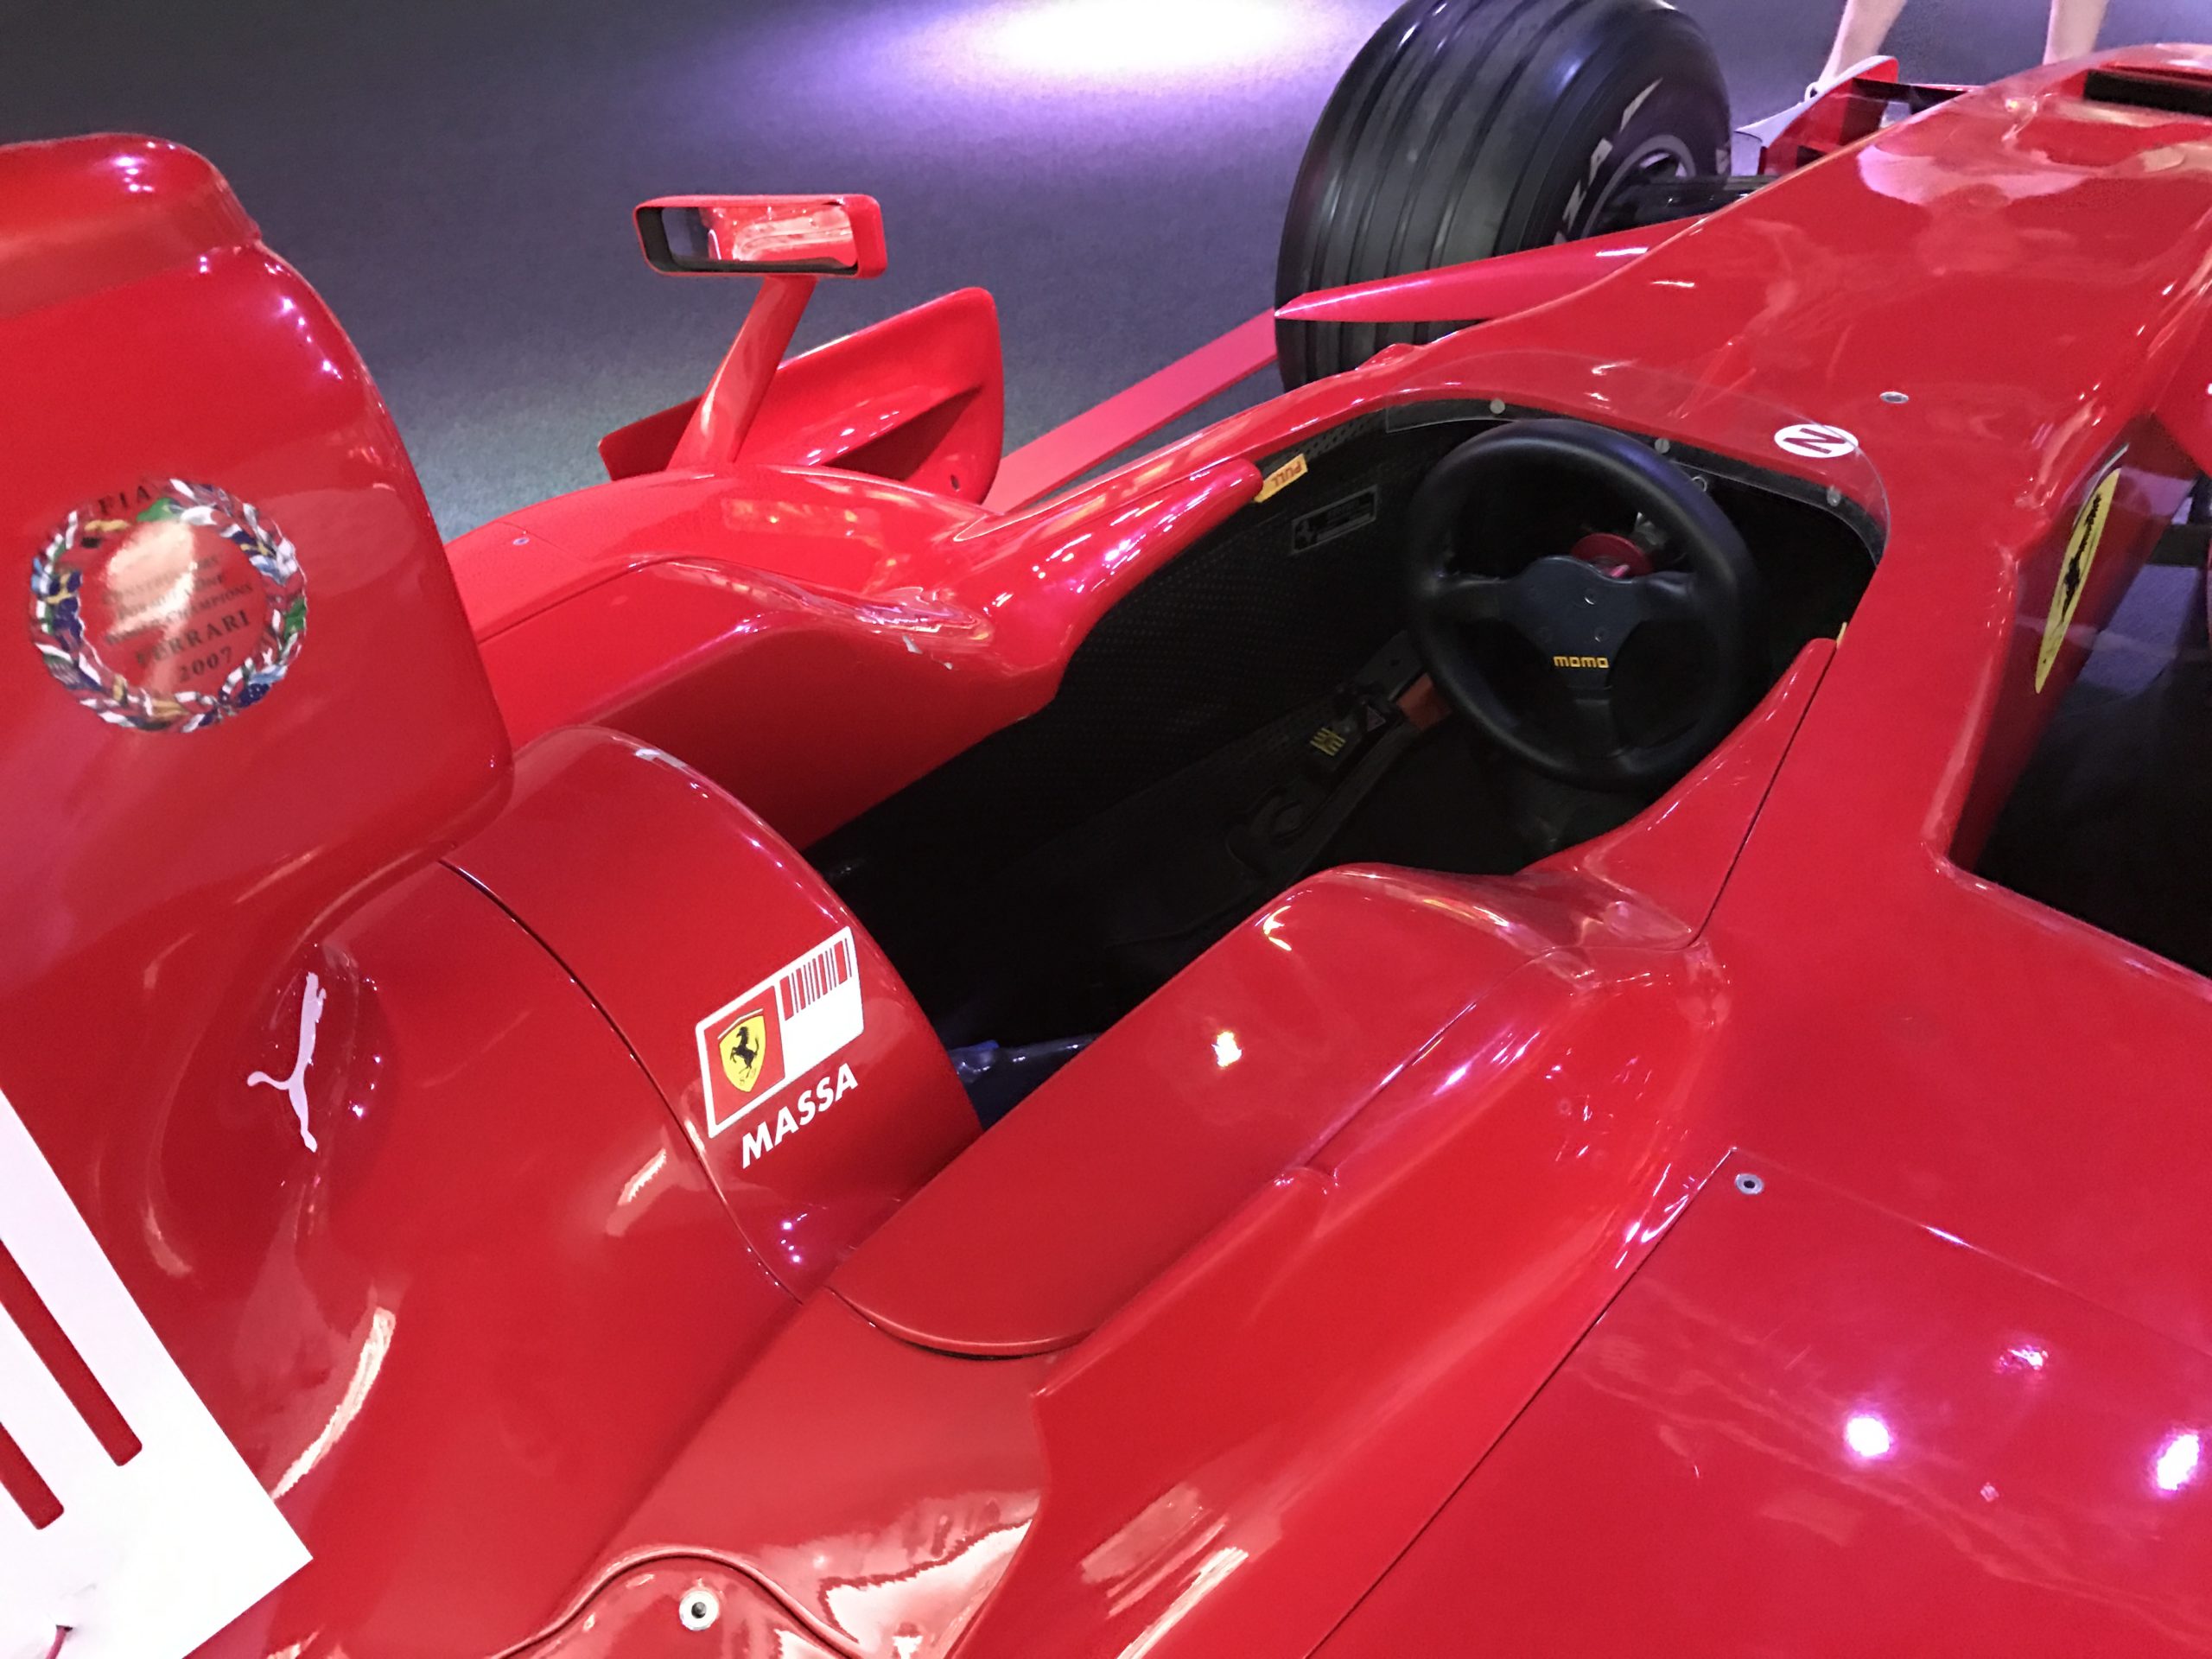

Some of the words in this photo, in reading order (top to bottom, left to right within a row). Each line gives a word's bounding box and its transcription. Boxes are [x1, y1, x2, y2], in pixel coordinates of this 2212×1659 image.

[1783, 428, 1846, 454] N
[1271, 461, 1302, 486] PULL
[98, 486, 151, 516] FIA
[179, 646, 232, 682] 2007
[742, 1063, 859, 1170] MASSA
